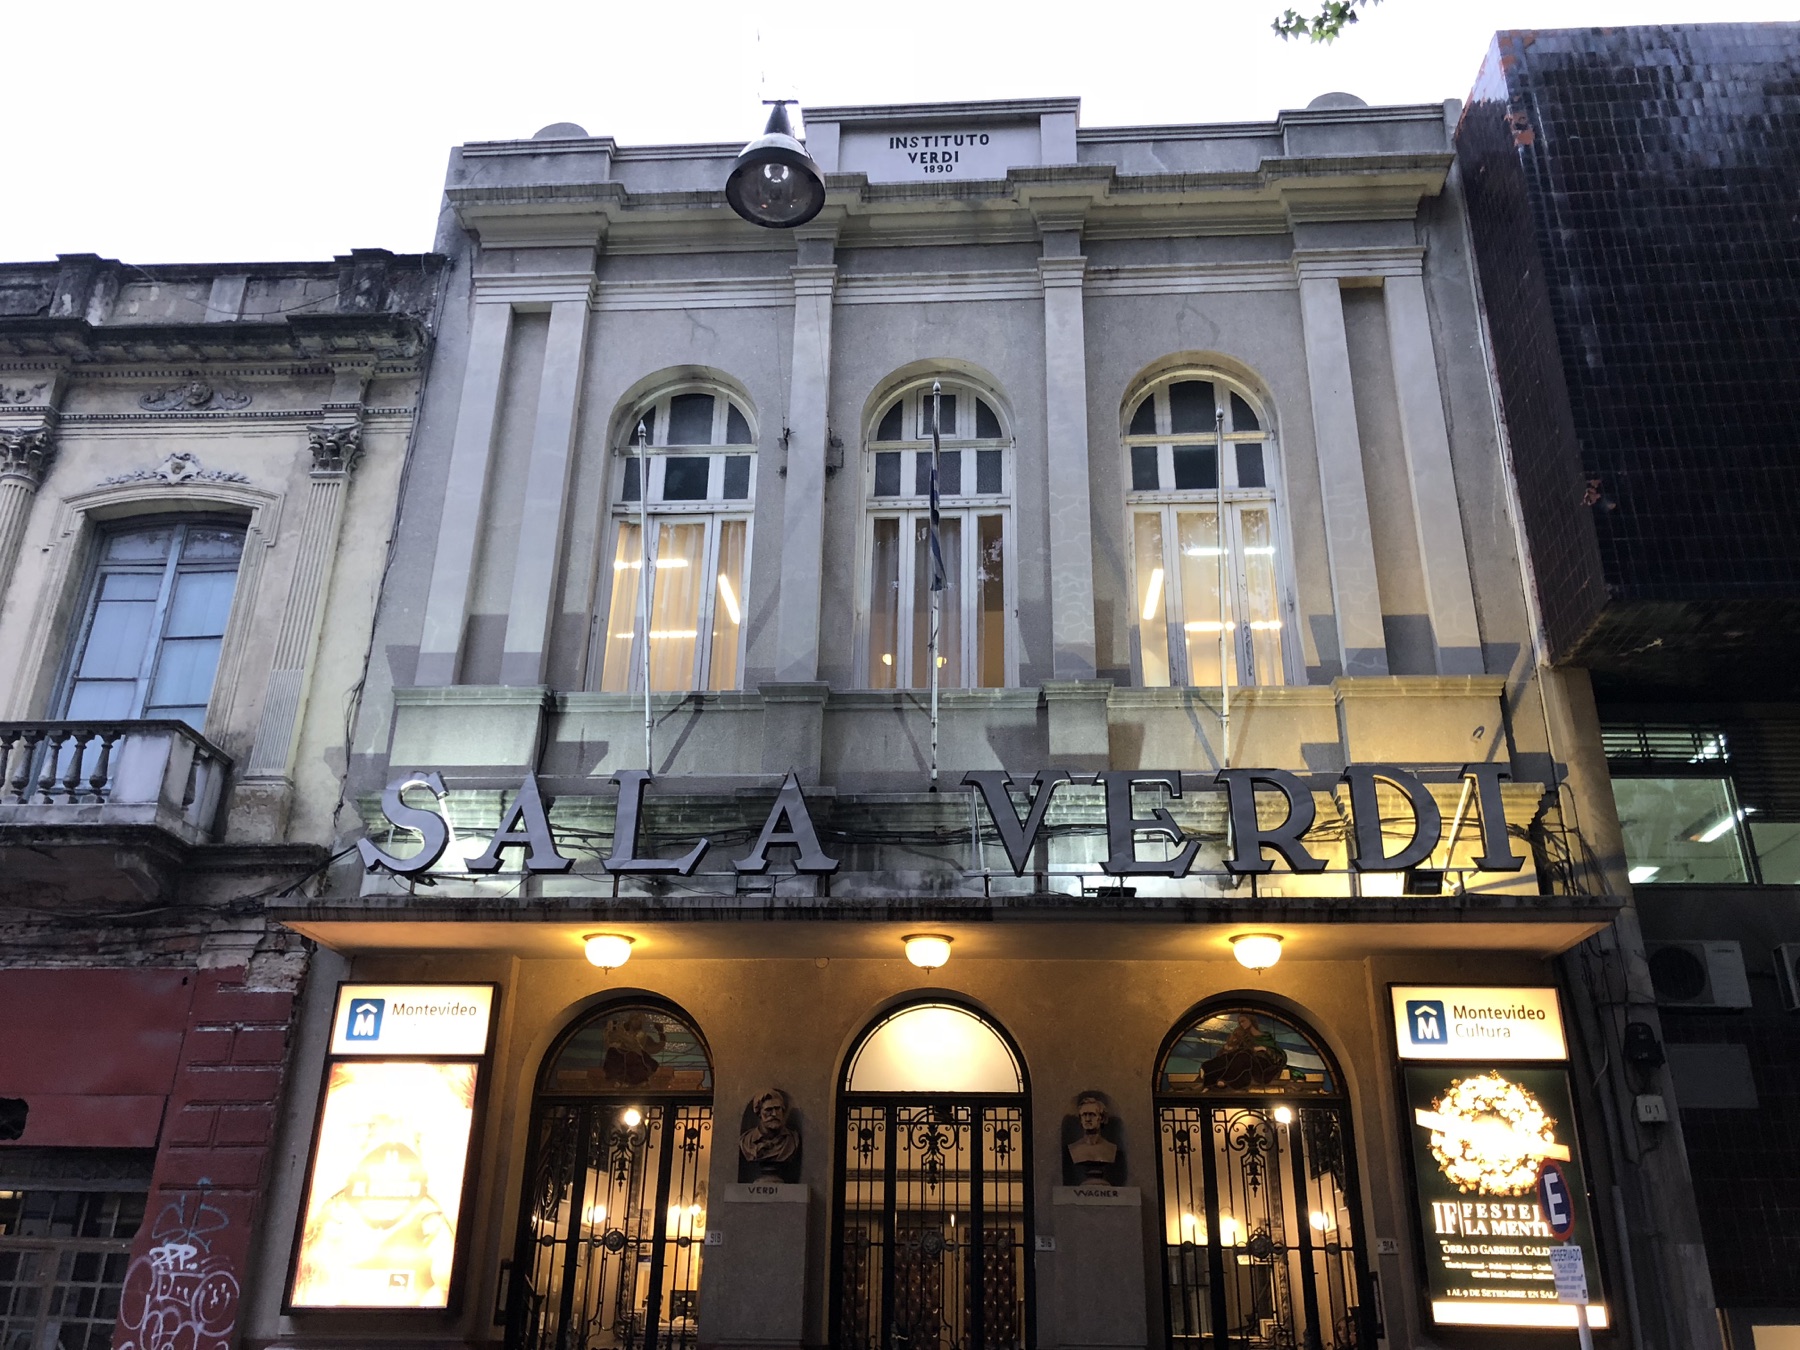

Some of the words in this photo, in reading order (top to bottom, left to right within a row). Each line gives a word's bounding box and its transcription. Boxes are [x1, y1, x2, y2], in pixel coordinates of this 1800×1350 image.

[889, 134, 990, 149] INSTITUTO
[908, 151, 959, 164] VERDI
[923, 164, 953, 173] 1890
[356, 766, 841, 876] SALA
[960, 762, 1528, 878] VERDI
[392, 1002, 477, 1016] Montevideo
[1453, 1005, 1546, 1020] Montevideo
[1455, 1023, 1511, 1038] Cultura
[748, 1186, 778, 1194] VERDI
[1073, 1189, 1119, 1197] WAGNER
[1543, 1172, 1567, 1226] E
[1462, 1203, 1541, 1222] FESTEJ
[1464, 1219, 1489, 1235] LA
[1490, 1220, 1553, 1237] MENTI
[1480, 1245, 1522, 1255] GABRIEL
[1523, 1246, 1551, 1256] CALD
